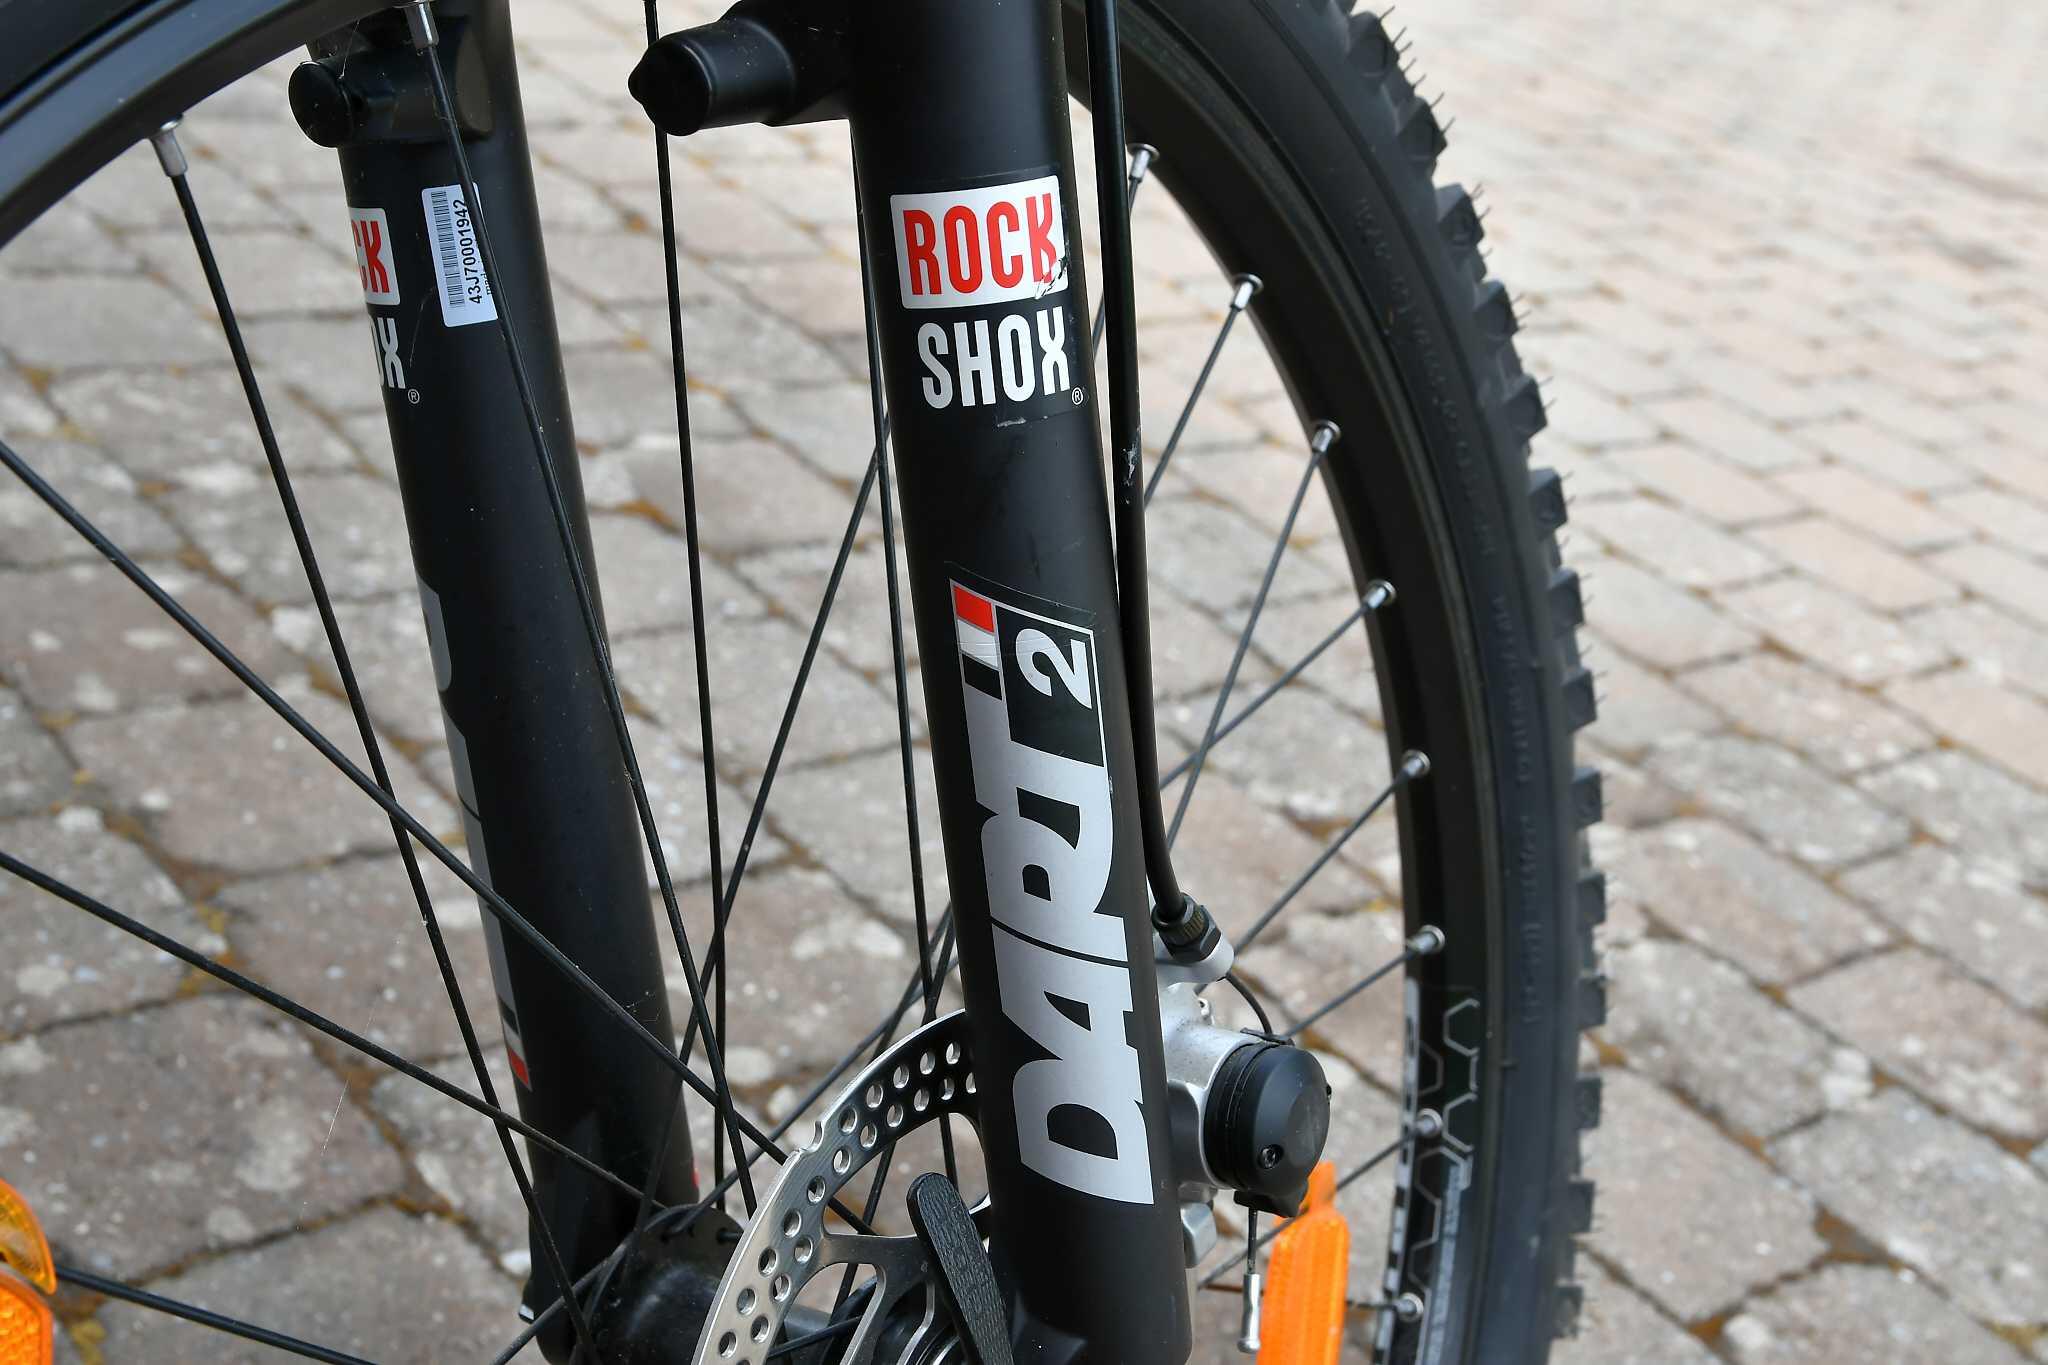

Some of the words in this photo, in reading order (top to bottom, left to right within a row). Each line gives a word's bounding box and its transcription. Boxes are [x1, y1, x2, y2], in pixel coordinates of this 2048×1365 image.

[453, 199, 482, 304] 43J70001942
[903, 193, 1057, 295] ROCK
[1016, 626, 1092, 709] 2
[965, 683, 1154, 1204] DART
